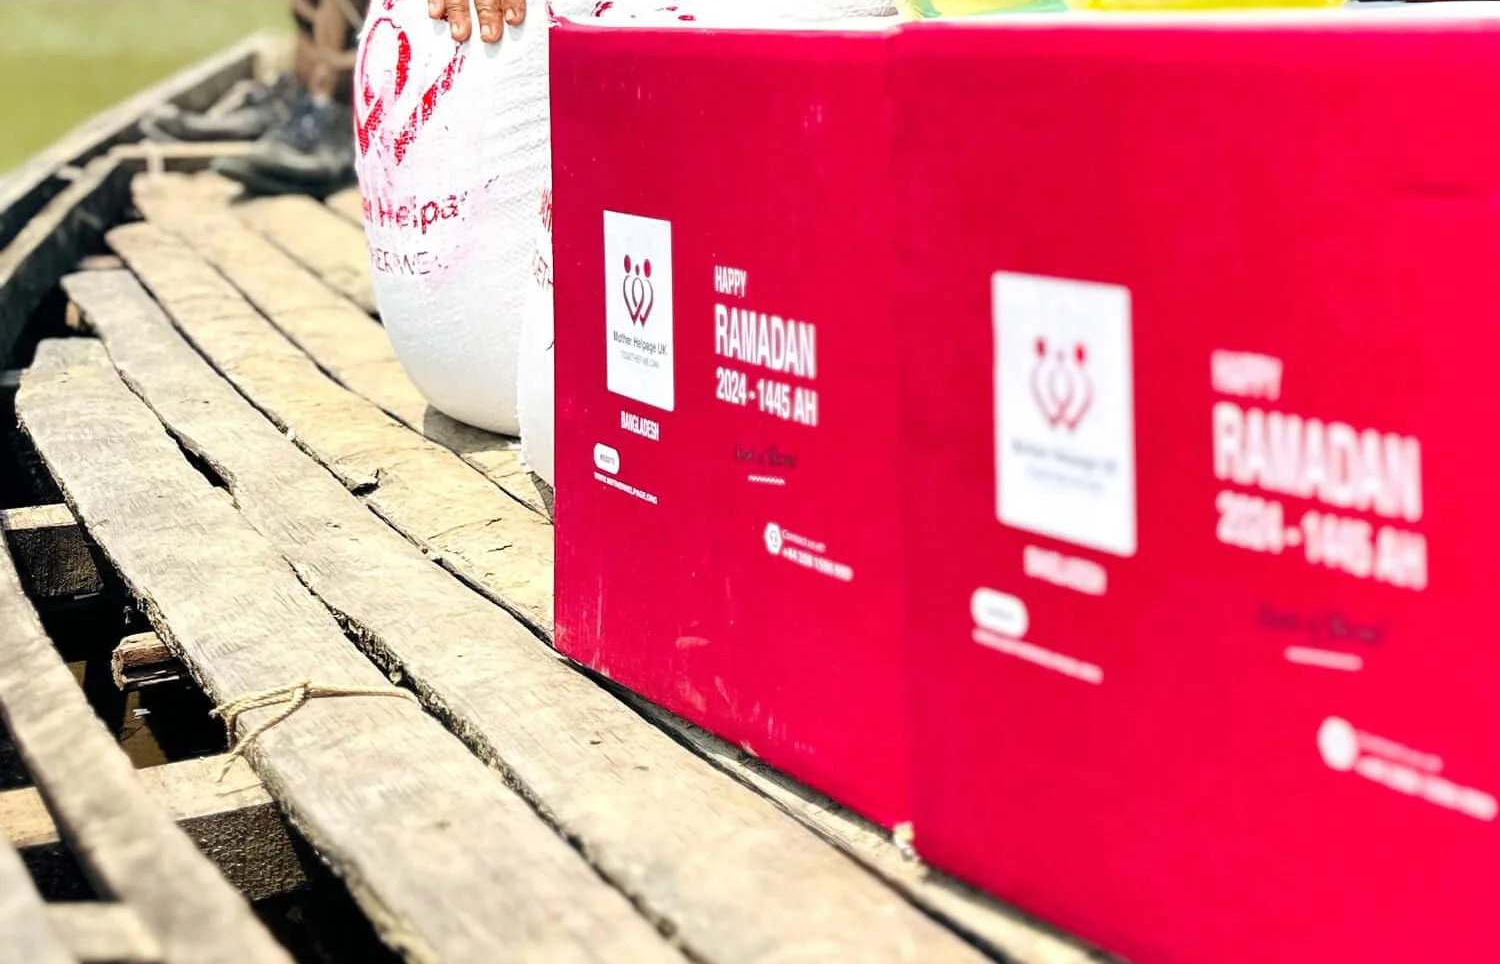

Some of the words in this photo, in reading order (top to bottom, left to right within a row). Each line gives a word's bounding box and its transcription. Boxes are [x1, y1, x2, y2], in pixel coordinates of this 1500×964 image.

[714, 265, 747, 298] HAPPY
[657, 342, 668, 356] UK
[714, 303, 816, 380] RAMADAN
[716, 366, 747, 406] 2024
[757, 378, 791, 420] 1445
[793, 386, 818, 427] AH
[620, 410, 660, 442] BANGLADESH
[1212, 400, 1423, 523] RAMADAN
